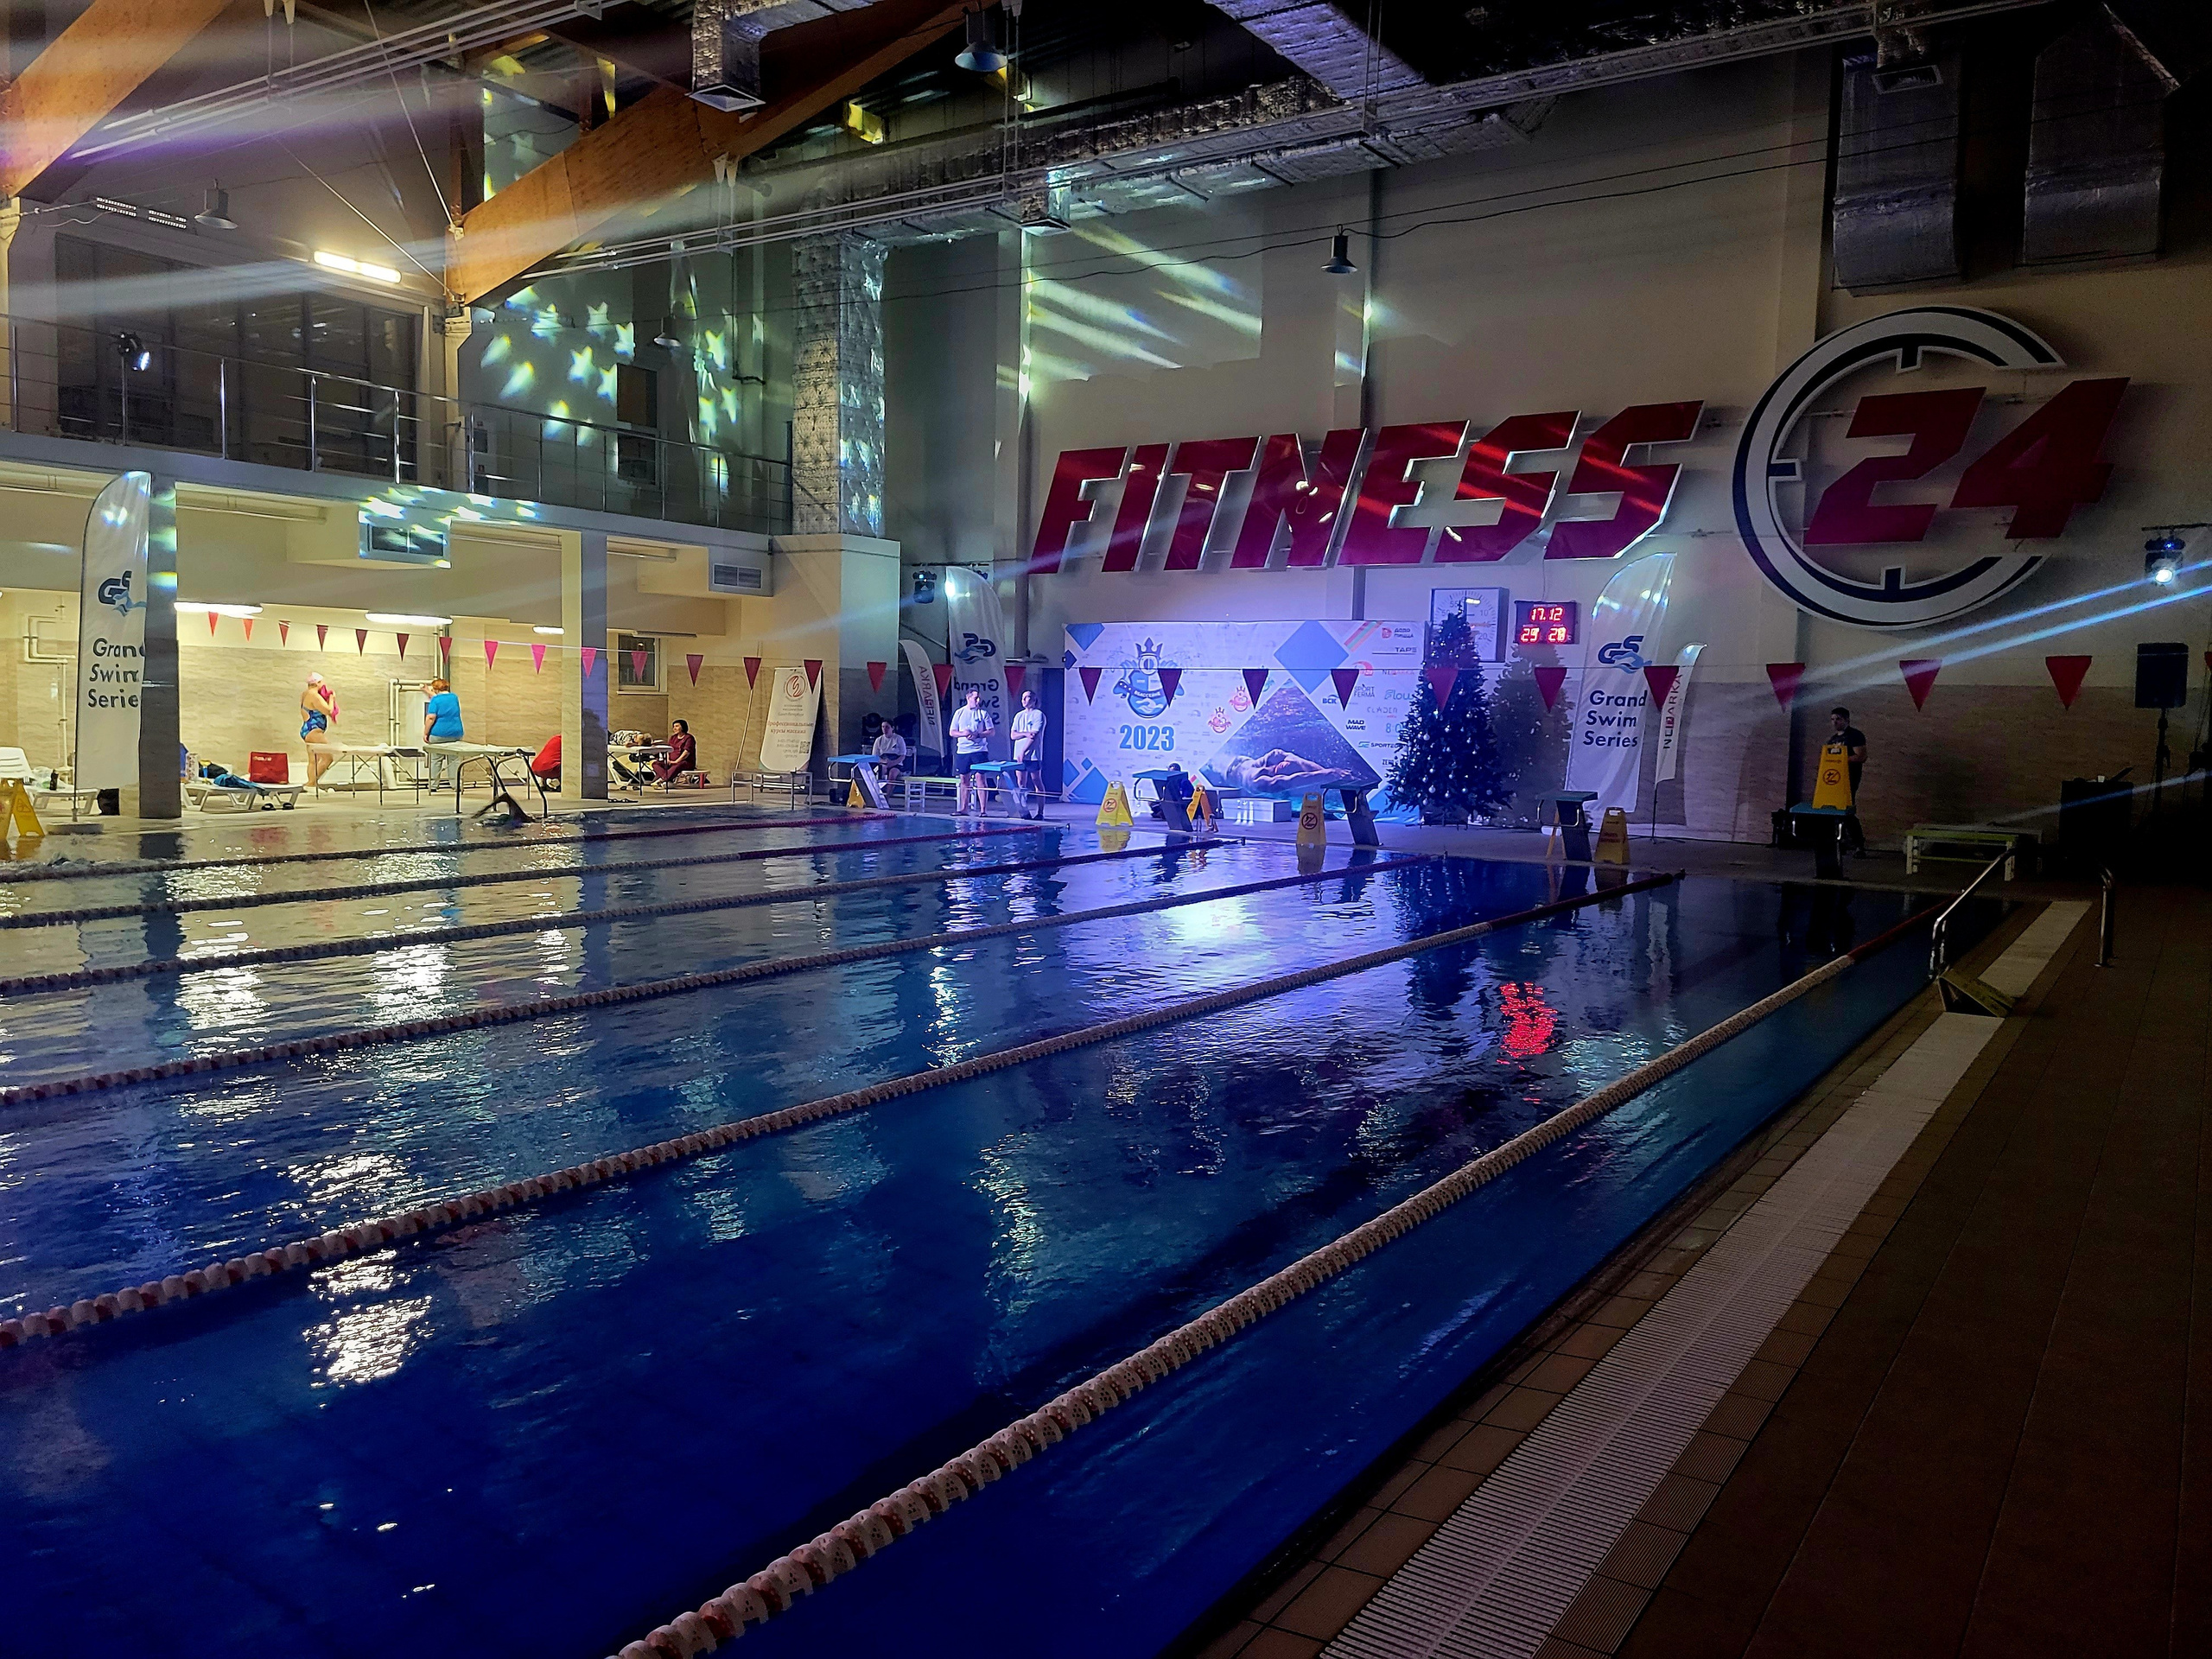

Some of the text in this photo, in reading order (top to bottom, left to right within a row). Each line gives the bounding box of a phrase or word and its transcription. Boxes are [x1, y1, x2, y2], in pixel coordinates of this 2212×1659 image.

[1031, 378, 2130, 574] FITNESS 24
[1590, 690, 1648, 707] Grand
[1586, 710, 1637, 728] Swim
[1119, 724, 1175, 752] 2023
[1583, 730, 1638, 747] Series
